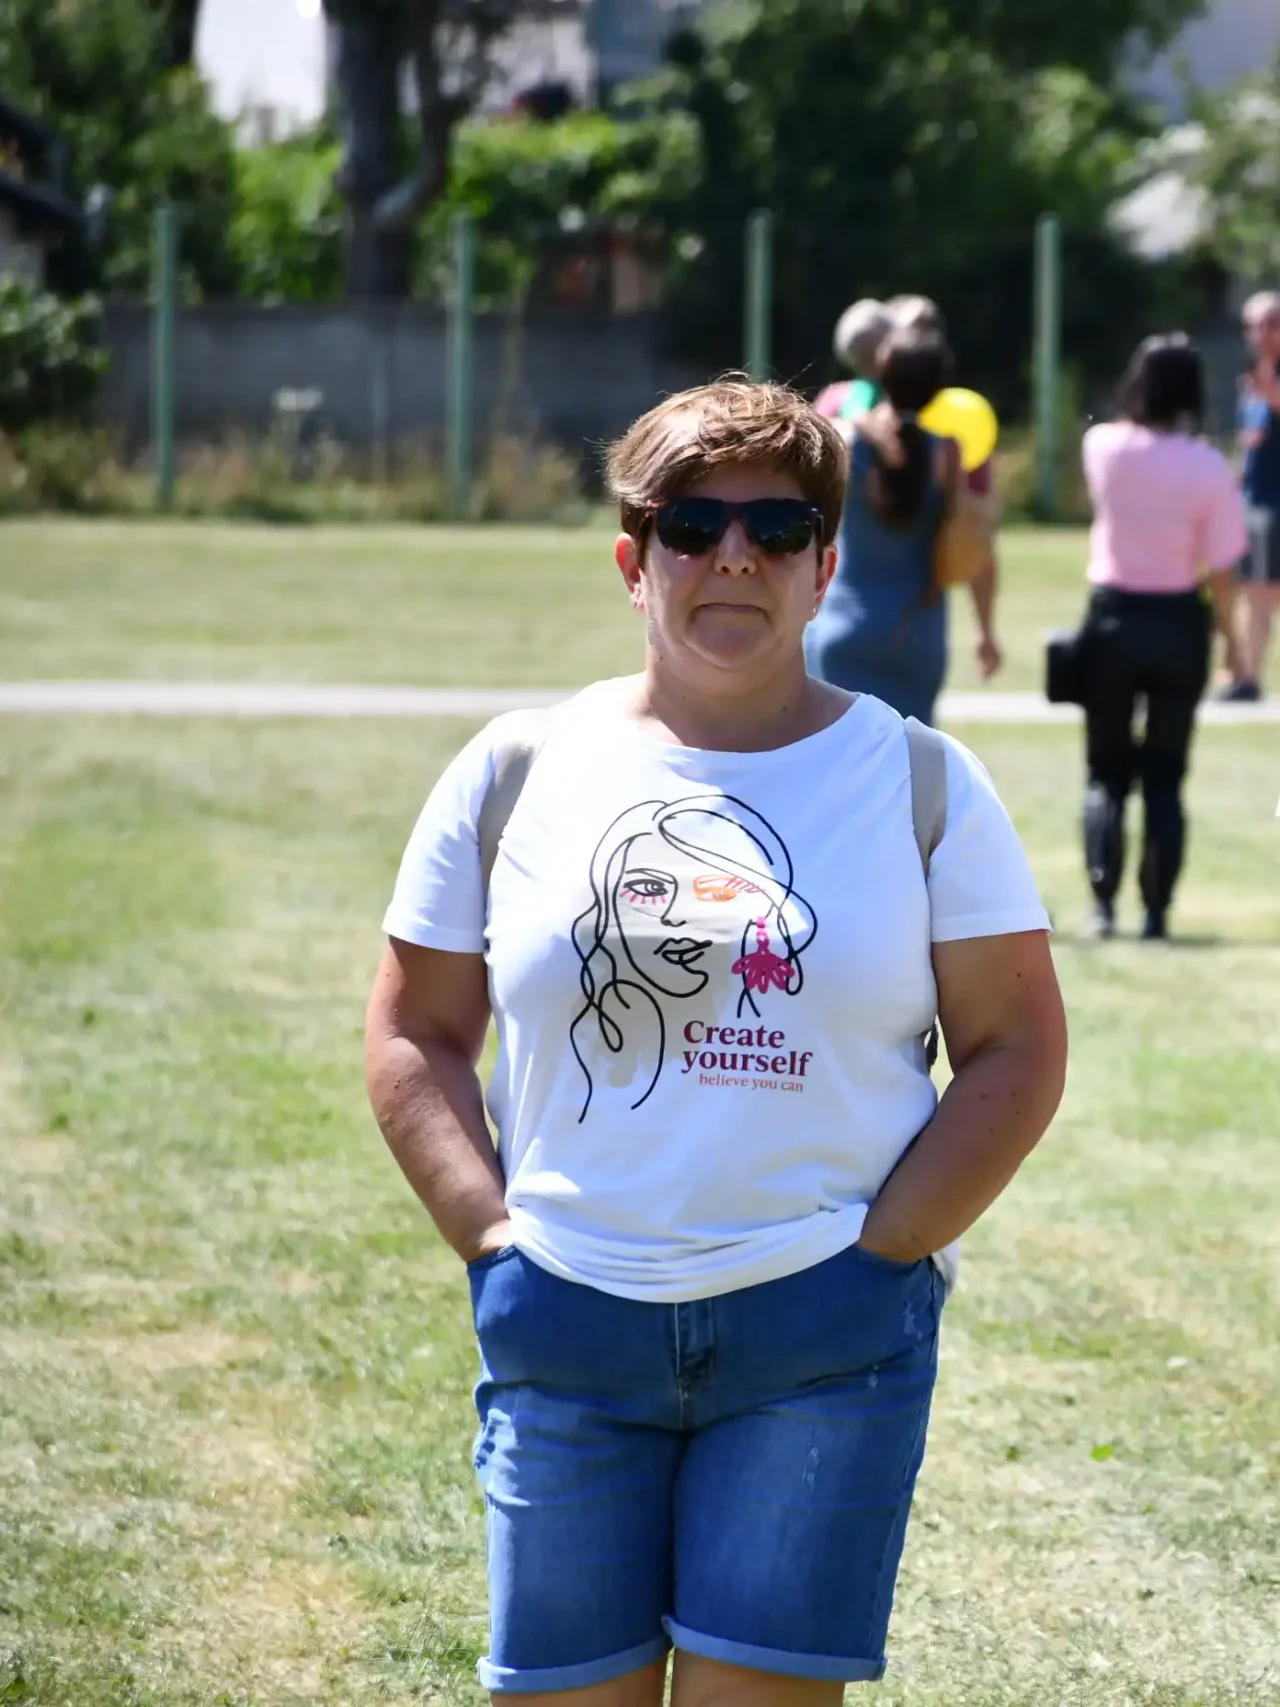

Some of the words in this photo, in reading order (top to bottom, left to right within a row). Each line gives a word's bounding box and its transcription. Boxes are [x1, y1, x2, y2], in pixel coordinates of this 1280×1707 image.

[683, 1020, 785, 1049] Create
[681, 1051, 813, 1076] yourself
[699, 1073, 749, 1087] believe
[751, 1077, 778, 1091] you
[780, 1080, 804, 1093] can
